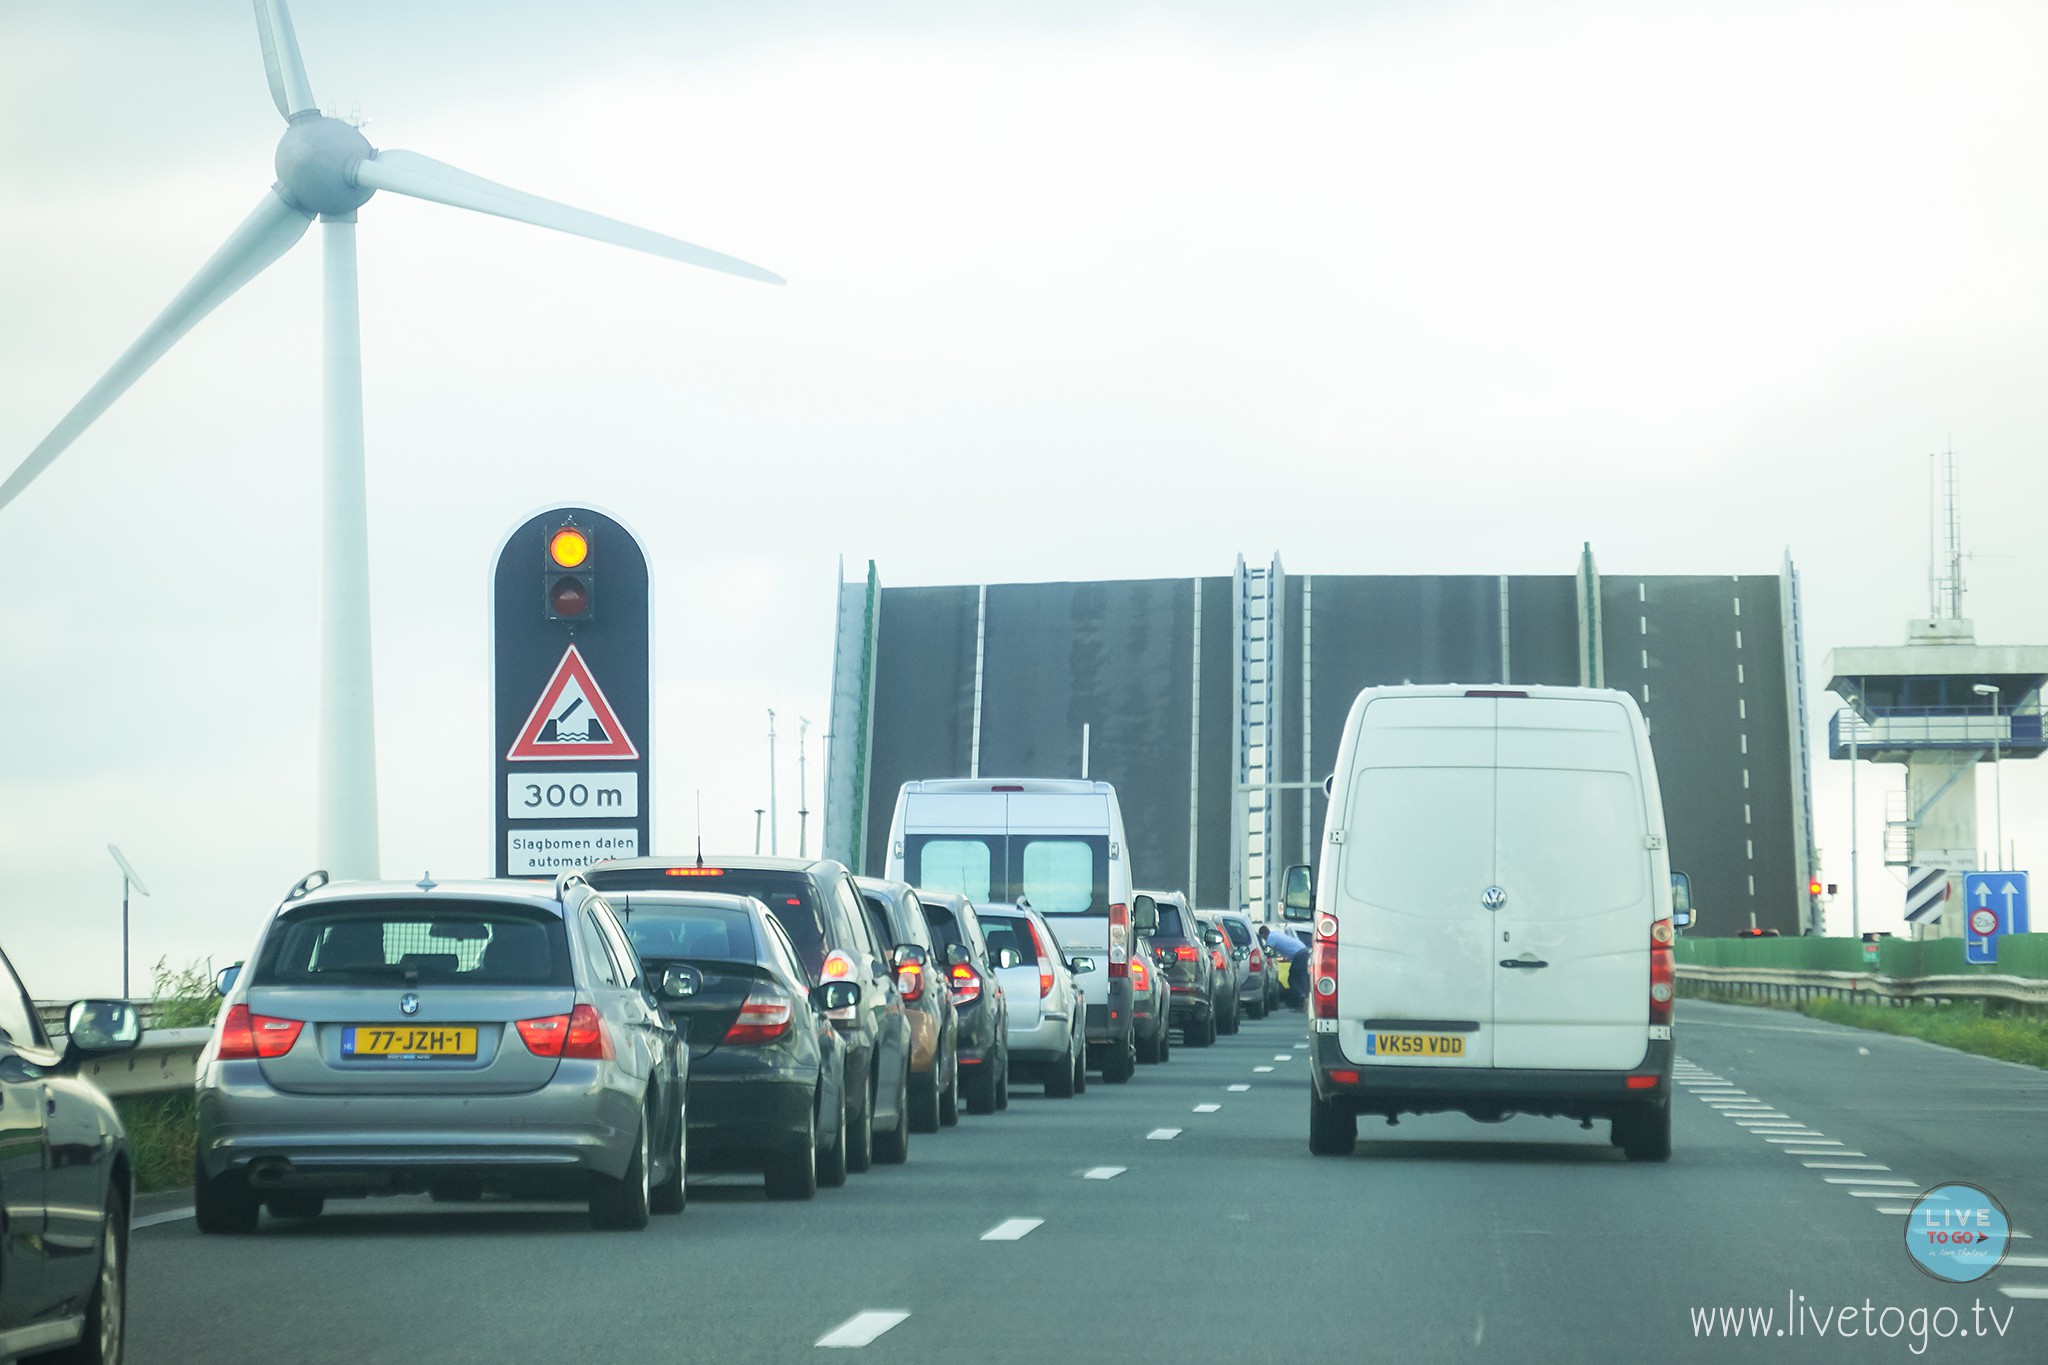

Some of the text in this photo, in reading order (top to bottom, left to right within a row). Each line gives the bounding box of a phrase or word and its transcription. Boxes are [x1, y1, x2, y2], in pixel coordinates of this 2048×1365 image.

[523, 783, 622, 808] 300 m
[513, 837, 634, 852] Slagbomen dalen
[368, 1031, 462, 1051] 77-JZH-1
[1379, 1034, 1462, 1053] VK59 VDD
